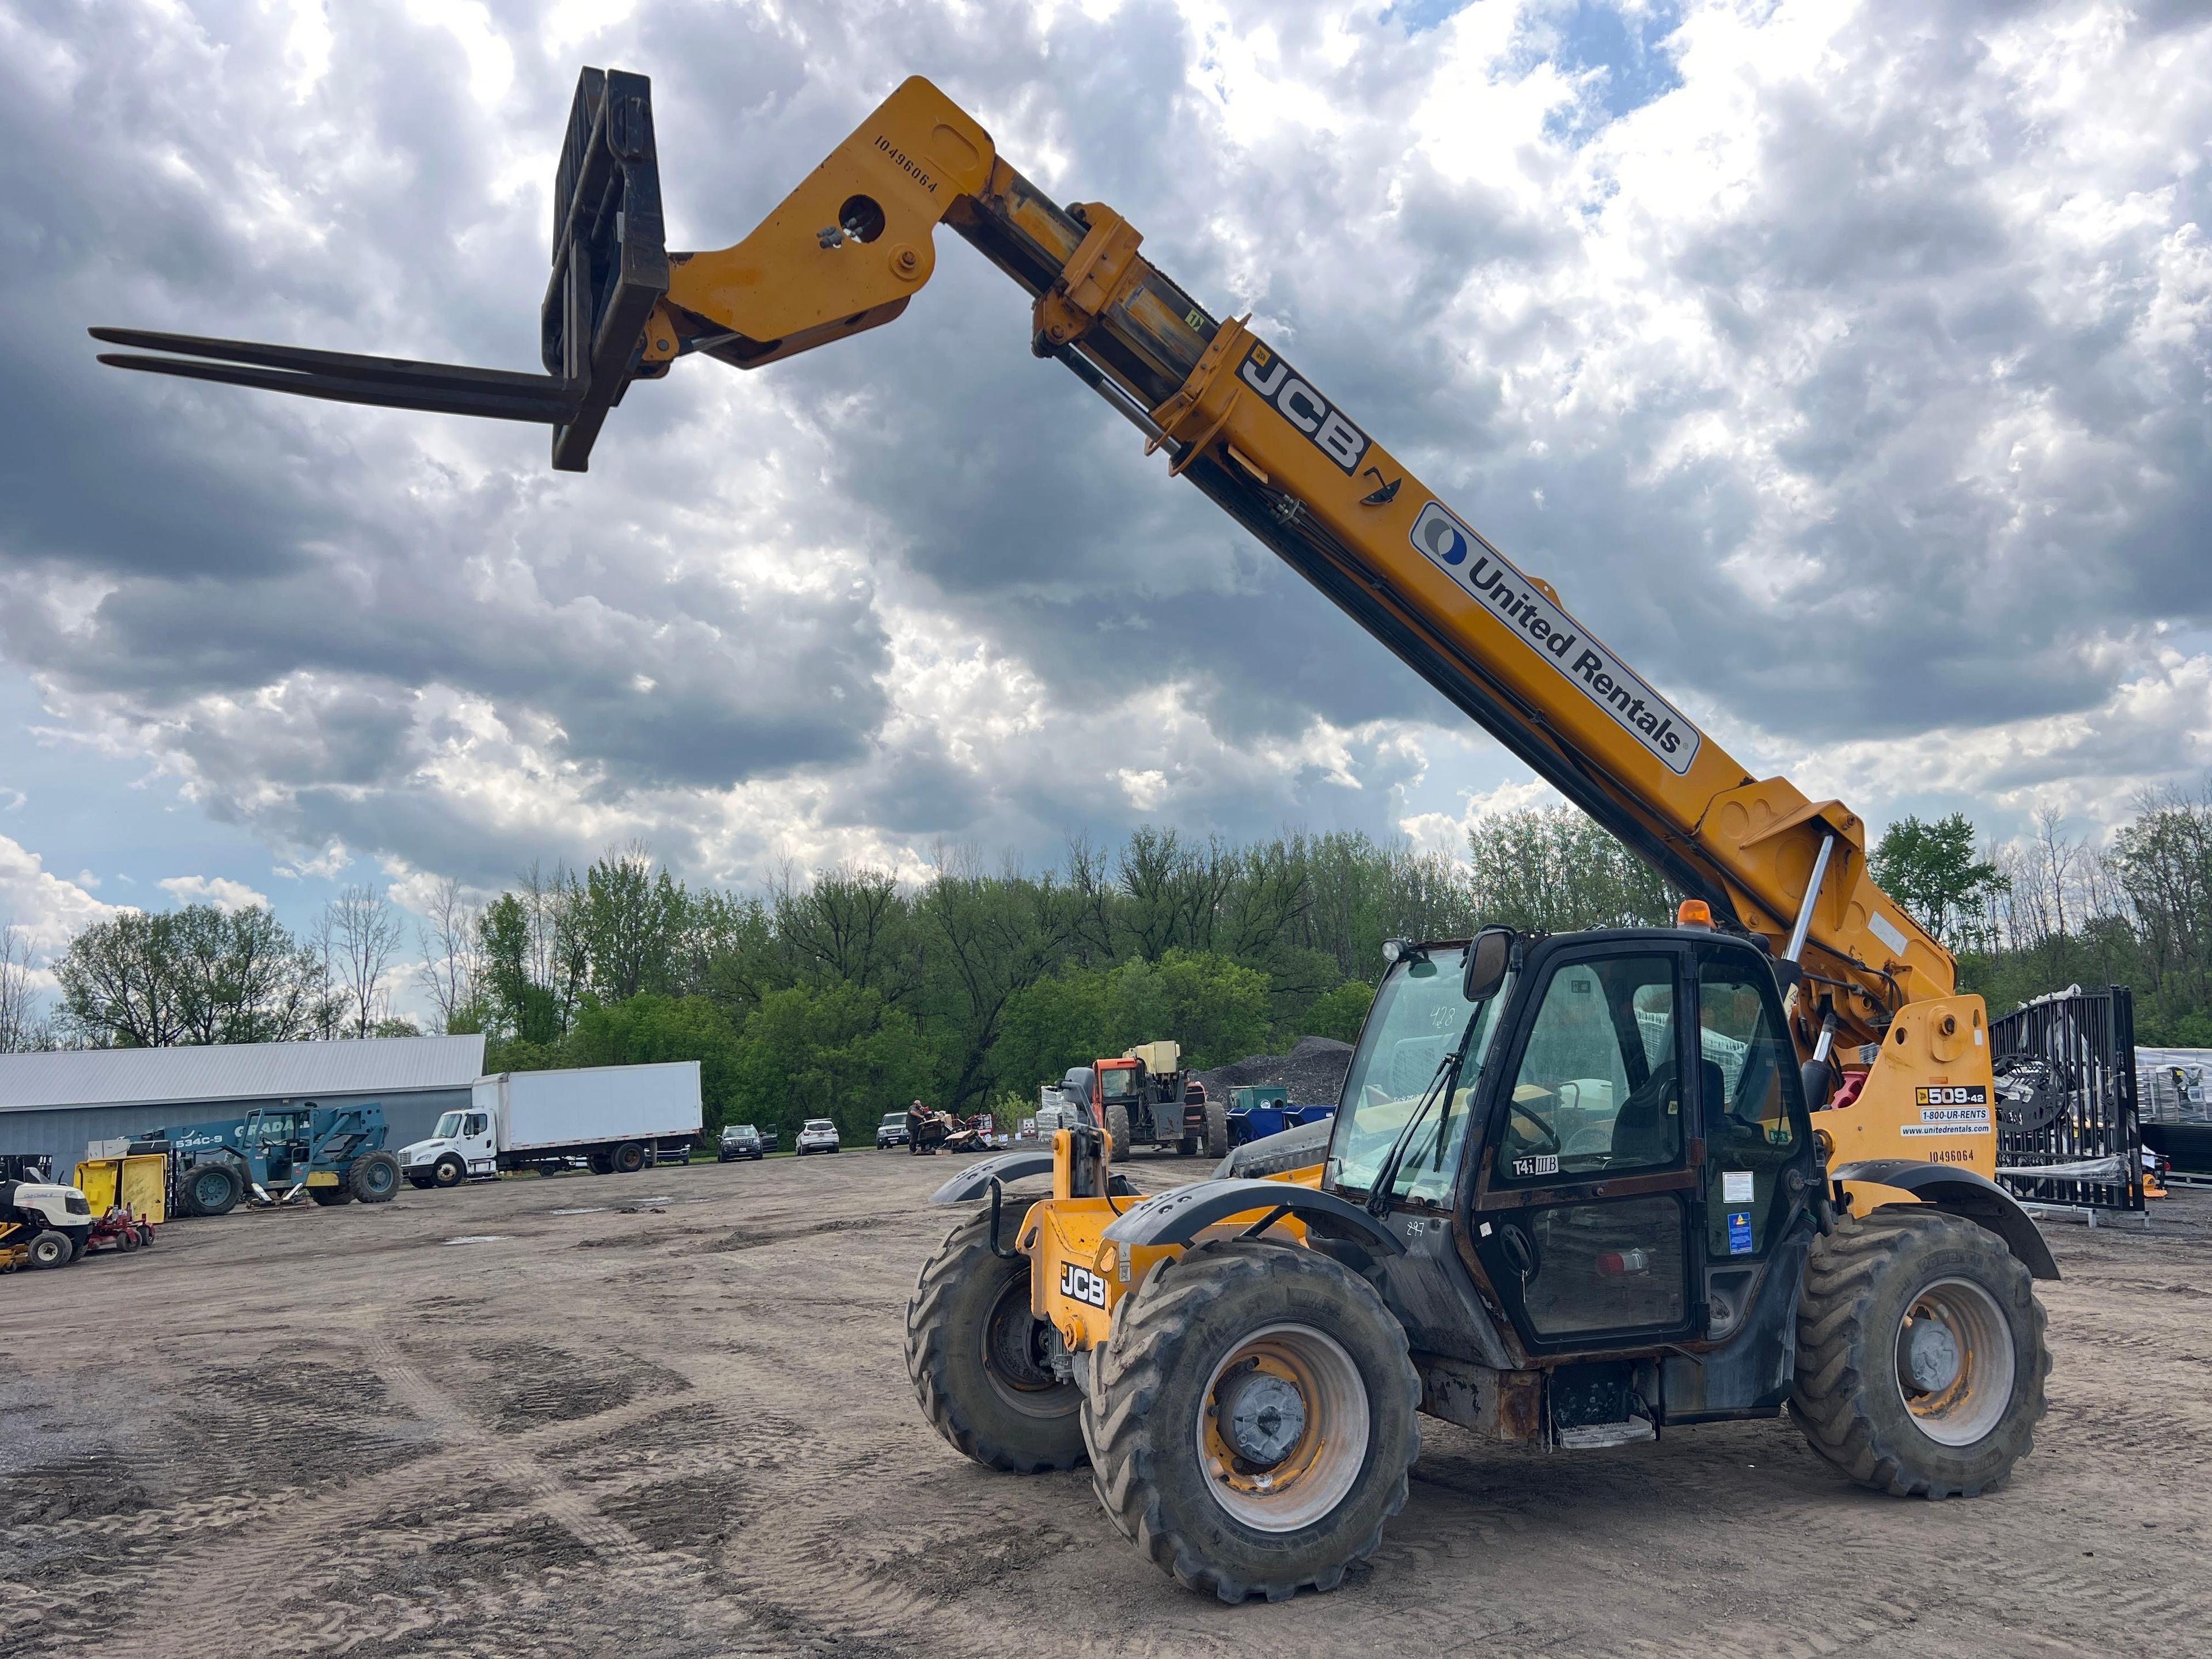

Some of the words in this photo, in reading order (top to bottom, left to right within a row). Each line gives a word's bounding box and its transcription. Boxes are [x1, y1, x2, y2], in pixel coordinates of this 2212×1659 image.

[874, 135, 938, 194] 10496064
[1190, 314, 1197, 324] 1
[1242, 360, 1365, 468] JCB
[1468, 556, 1577, 658] United
[1570, 648, 1681, 755] Rentals
[1430, 1006, 1456, 1028] 428
[1929, 1088, 1984, 1104] 509-42
[1923, 1109, 1986, 1120] 1-800-UR-RENTS
[234, 1120, 310, 1137] GRADAL
[1903, 1124, 1989, 1135] www.unitedrentals.com
[176, 1135, 223, 1148] 534C-9
[1929, 1149, 1974, 1162] 10496064
[1062, 1265, 1104, 1306] JCB
